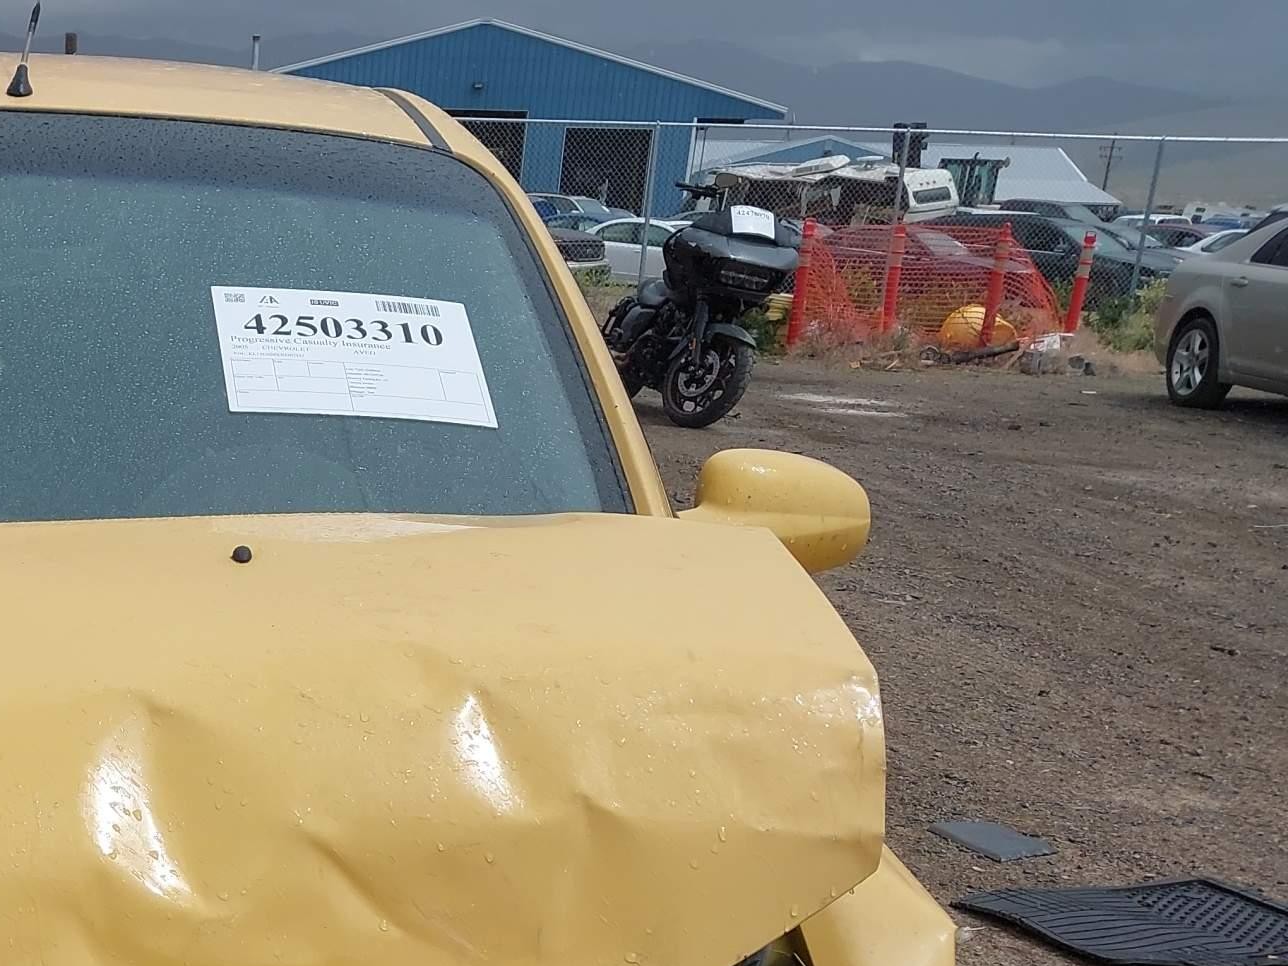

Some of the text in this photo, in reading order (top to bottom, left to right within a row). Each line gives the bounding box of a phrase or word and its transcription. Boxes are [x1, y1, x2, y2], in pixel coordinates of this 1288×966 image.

[243, 313, 444, 347] 42503310
[230, 335, 391, 350] Progressive Casualty Insurance
